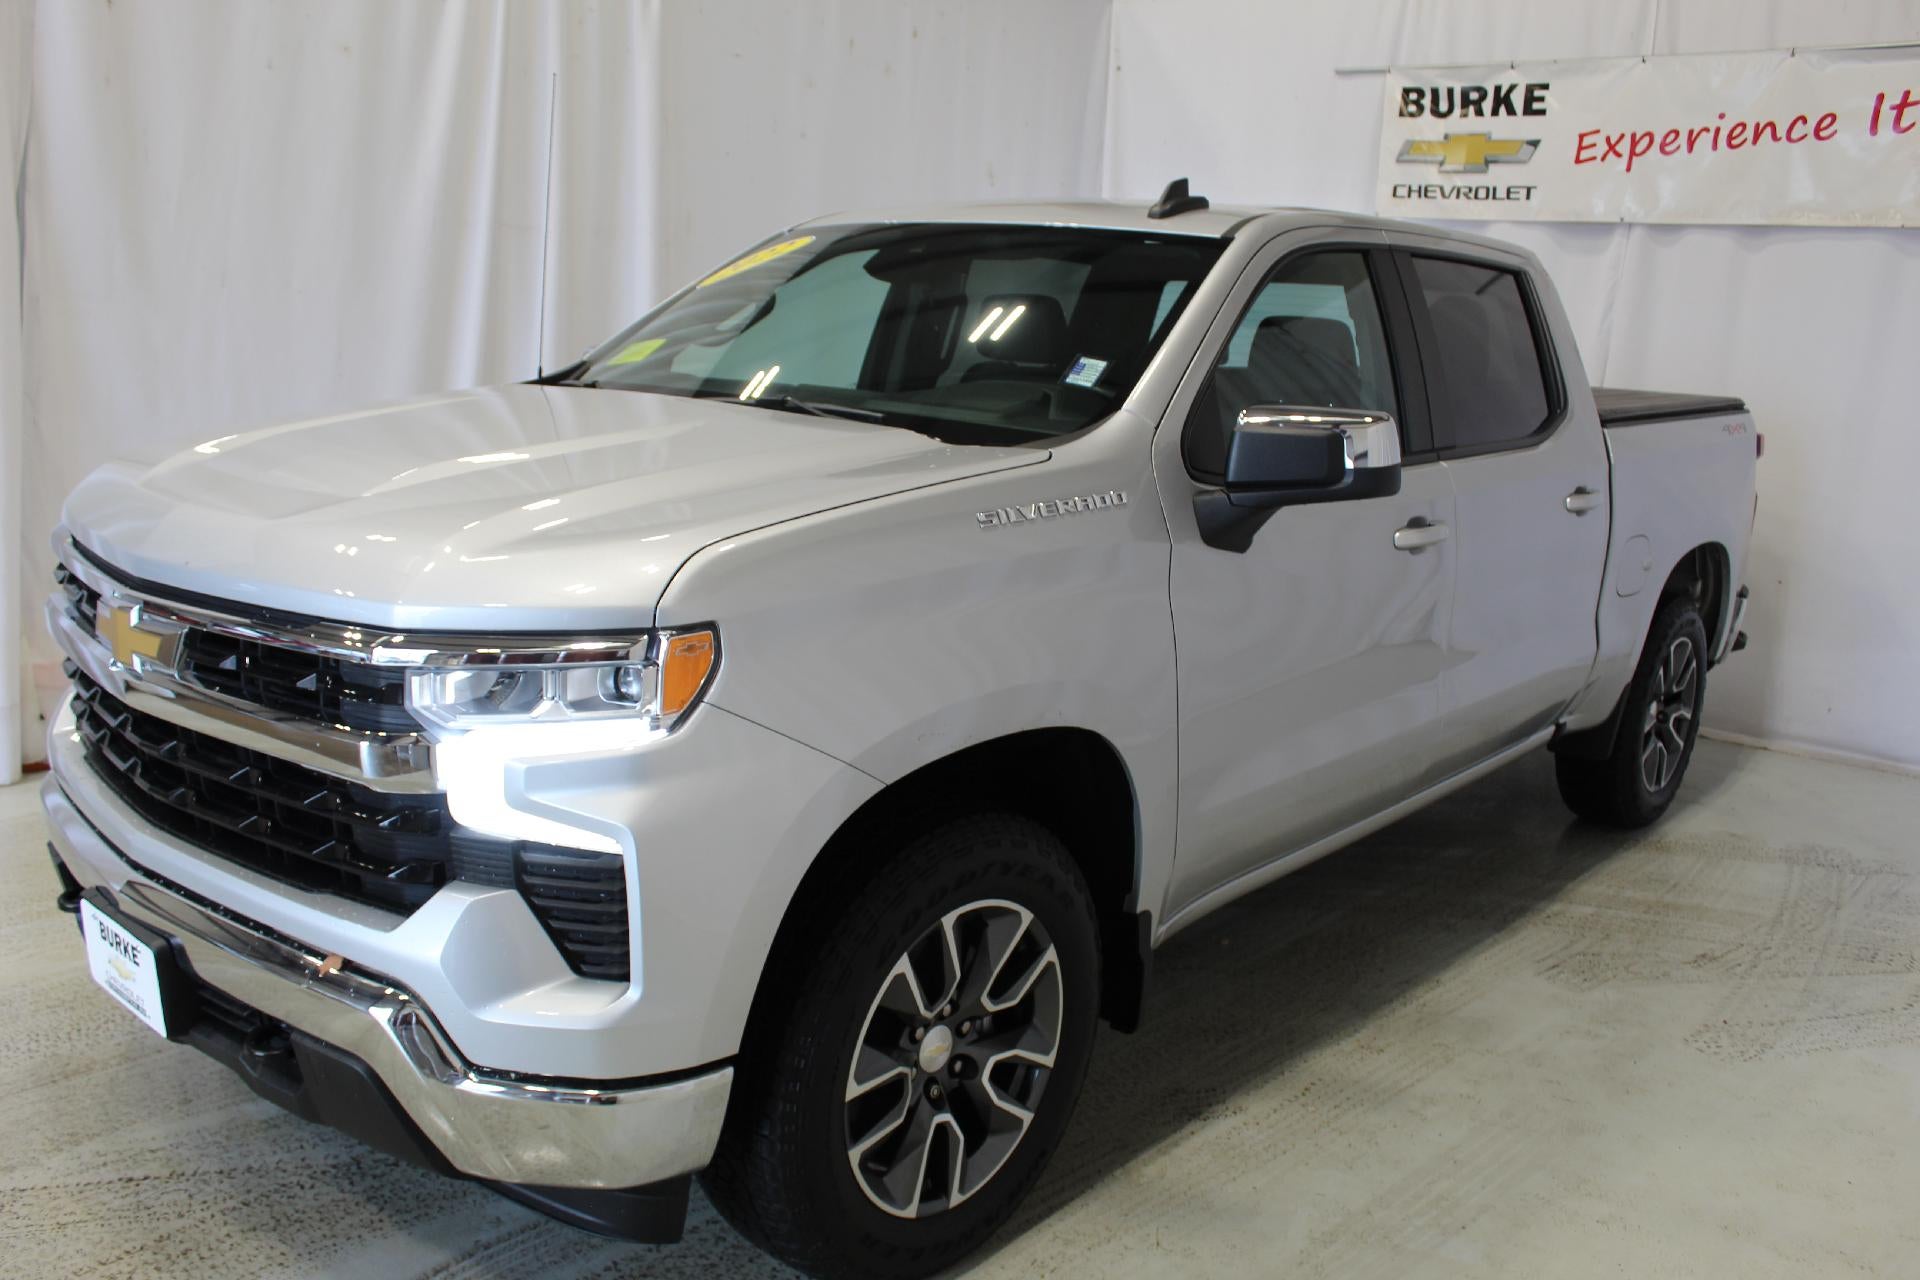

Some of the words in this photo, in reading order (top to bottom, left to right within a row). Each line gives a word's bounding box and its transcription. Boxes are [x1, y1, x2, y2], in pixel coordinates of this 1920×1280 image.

[1399, 83, 1549, 118] BURKE
[1574, 112, 1838, 173] Experience
[1869, 90, 1920, 136] It
[1393, 184, 1537, 201] CHEVROLET
[976, 491, 1127, 529] SILVERADO
[99, 920, 141, 967] BURKE
